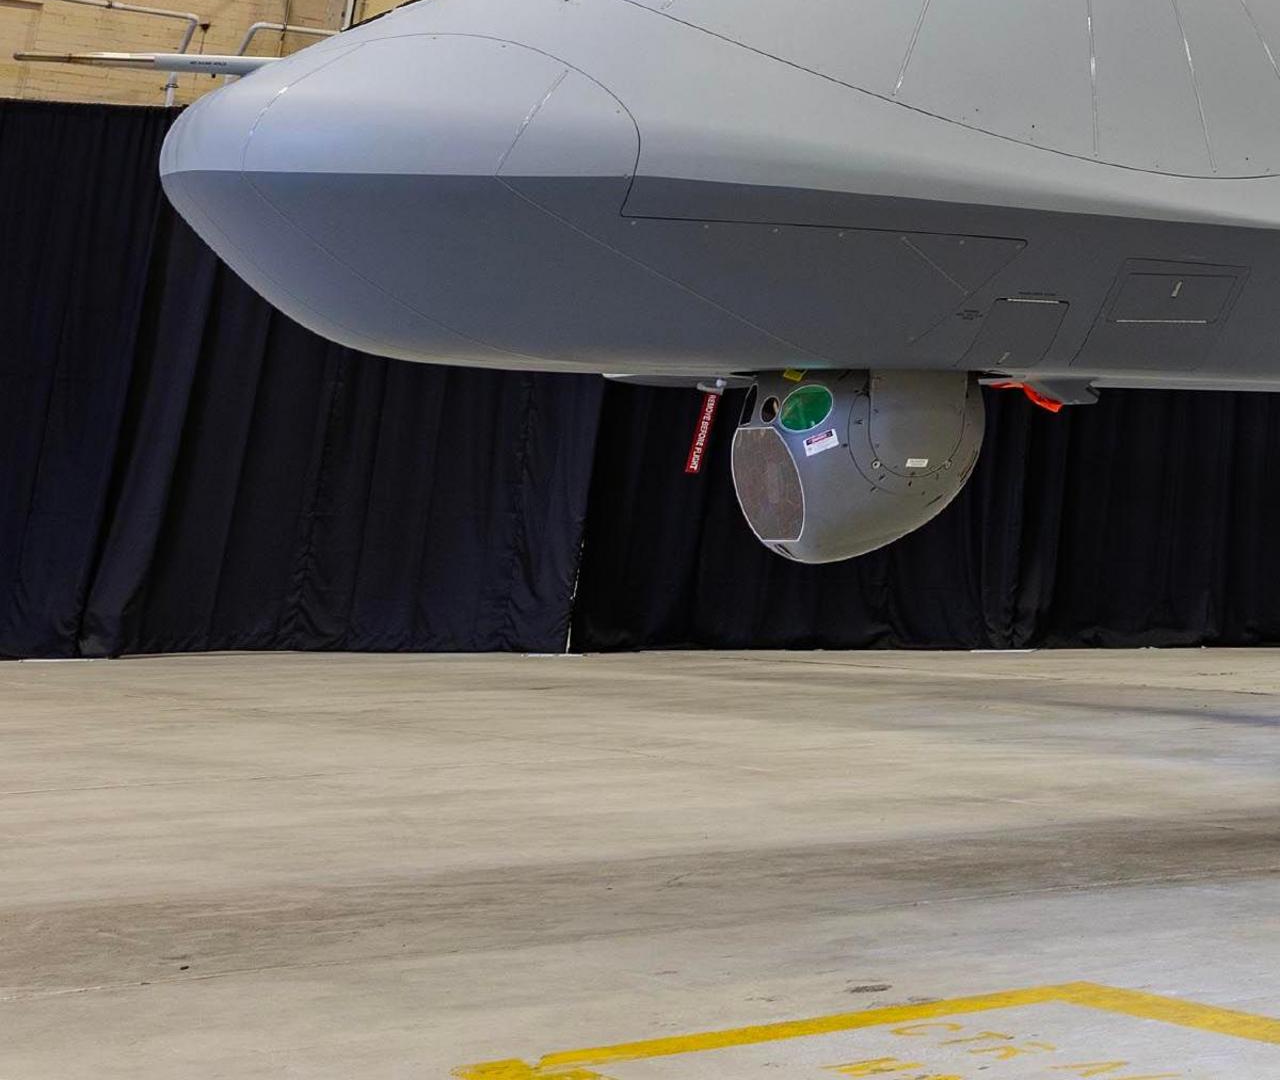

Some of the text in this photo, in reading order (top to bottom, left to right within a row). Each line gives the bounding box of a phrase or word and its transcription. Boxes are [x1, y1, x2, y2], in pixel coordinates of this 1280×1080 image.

[689, 394, 717, 471] REMOVE BEFORE FLIGHT
